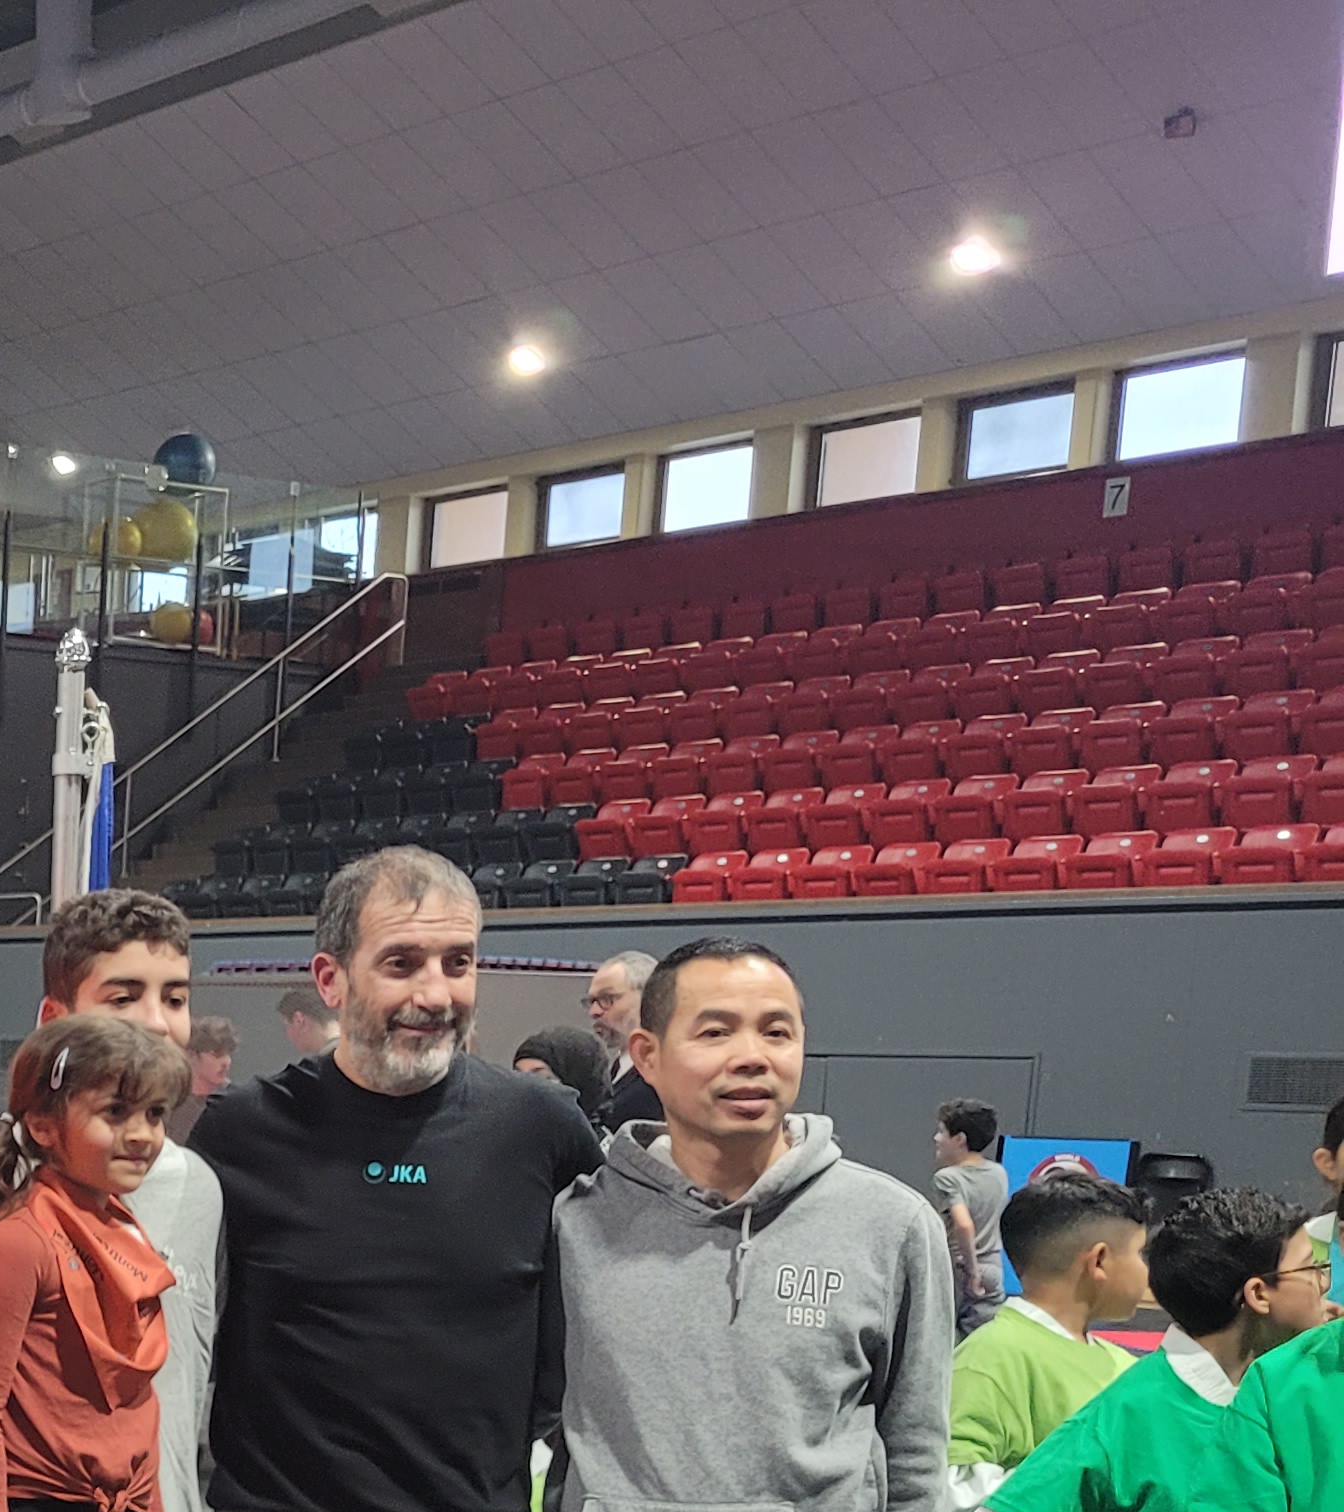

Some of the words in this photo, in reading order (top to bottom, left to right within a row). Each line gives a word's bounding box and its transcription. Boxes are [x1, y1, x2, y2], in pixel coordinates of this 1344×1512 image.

[1109, 483, 1126, 510] 7
[388, 1164, 427, 1184] JKA
[776, 1264, 844, 1306] GAP
[786, 1305, 826, 1328] 1969
